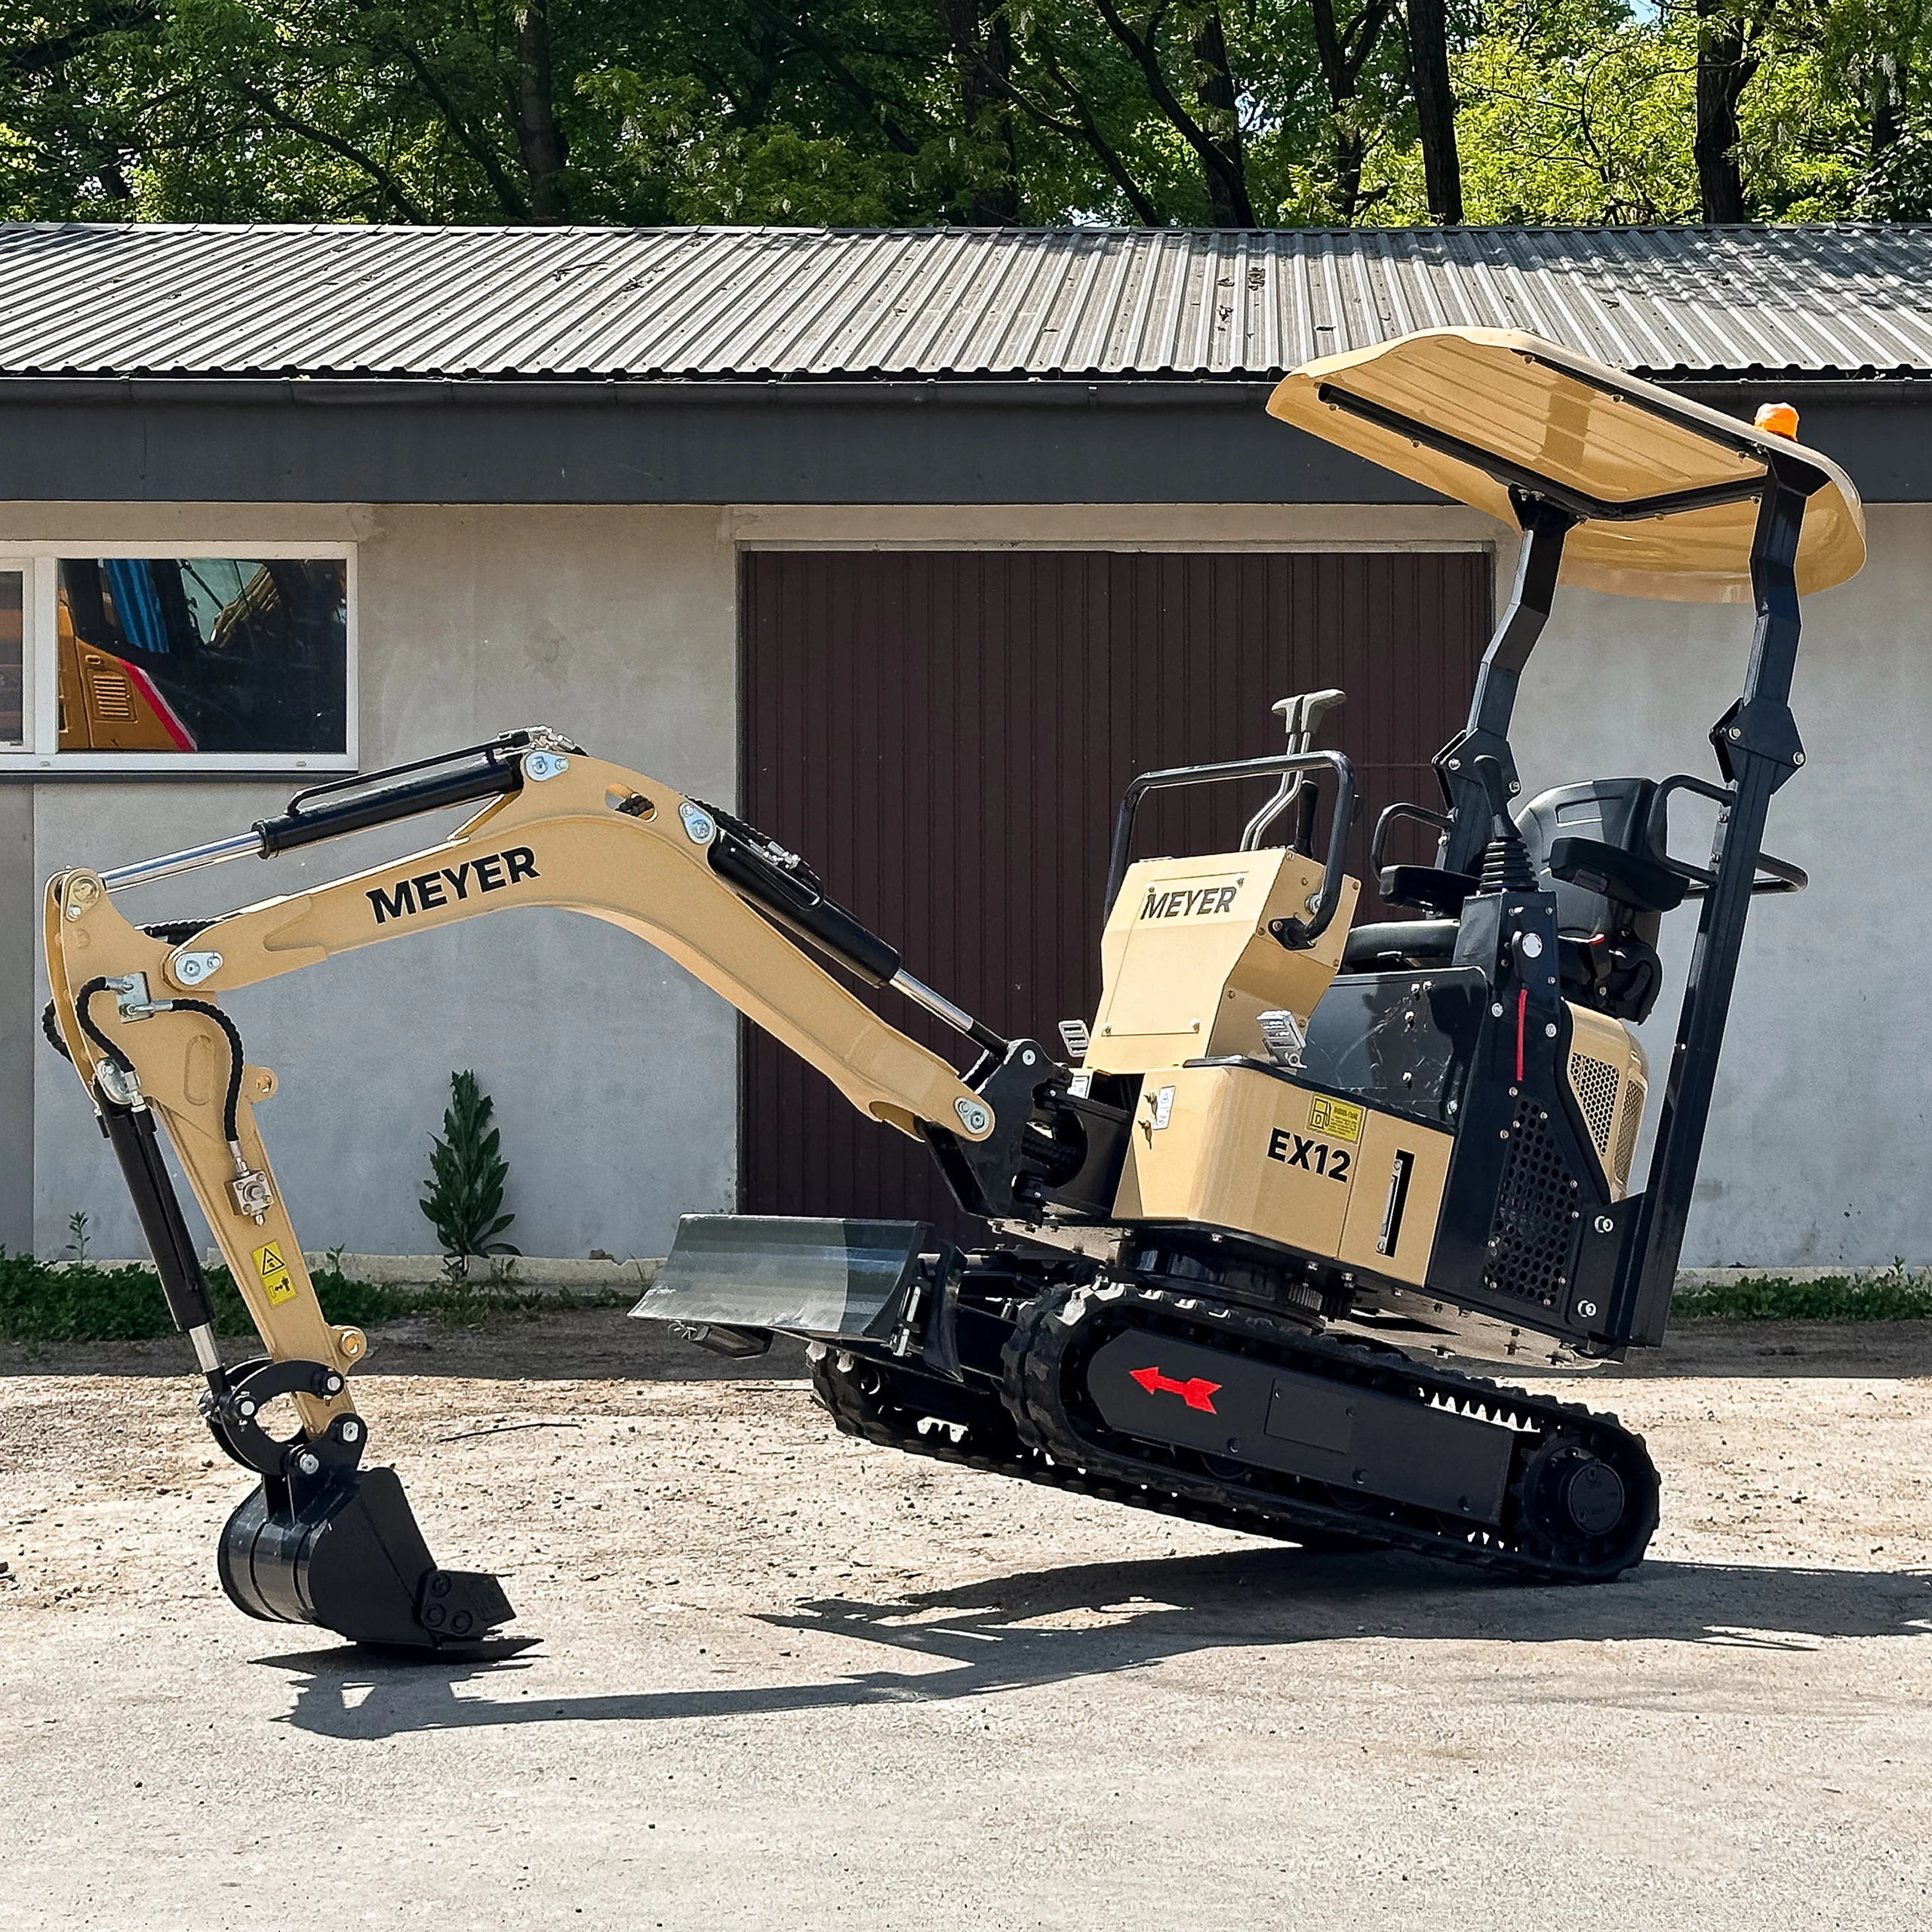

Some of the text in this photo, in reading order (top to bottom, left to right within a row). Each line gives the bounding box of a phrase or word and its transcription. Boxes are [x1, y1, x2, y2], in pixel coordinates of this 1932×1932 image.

[366, 846, 541, 924] MEYER
[1140, 887, 1236, 920] MEYER
[1267, 1128, 1351, 1183] EX12
